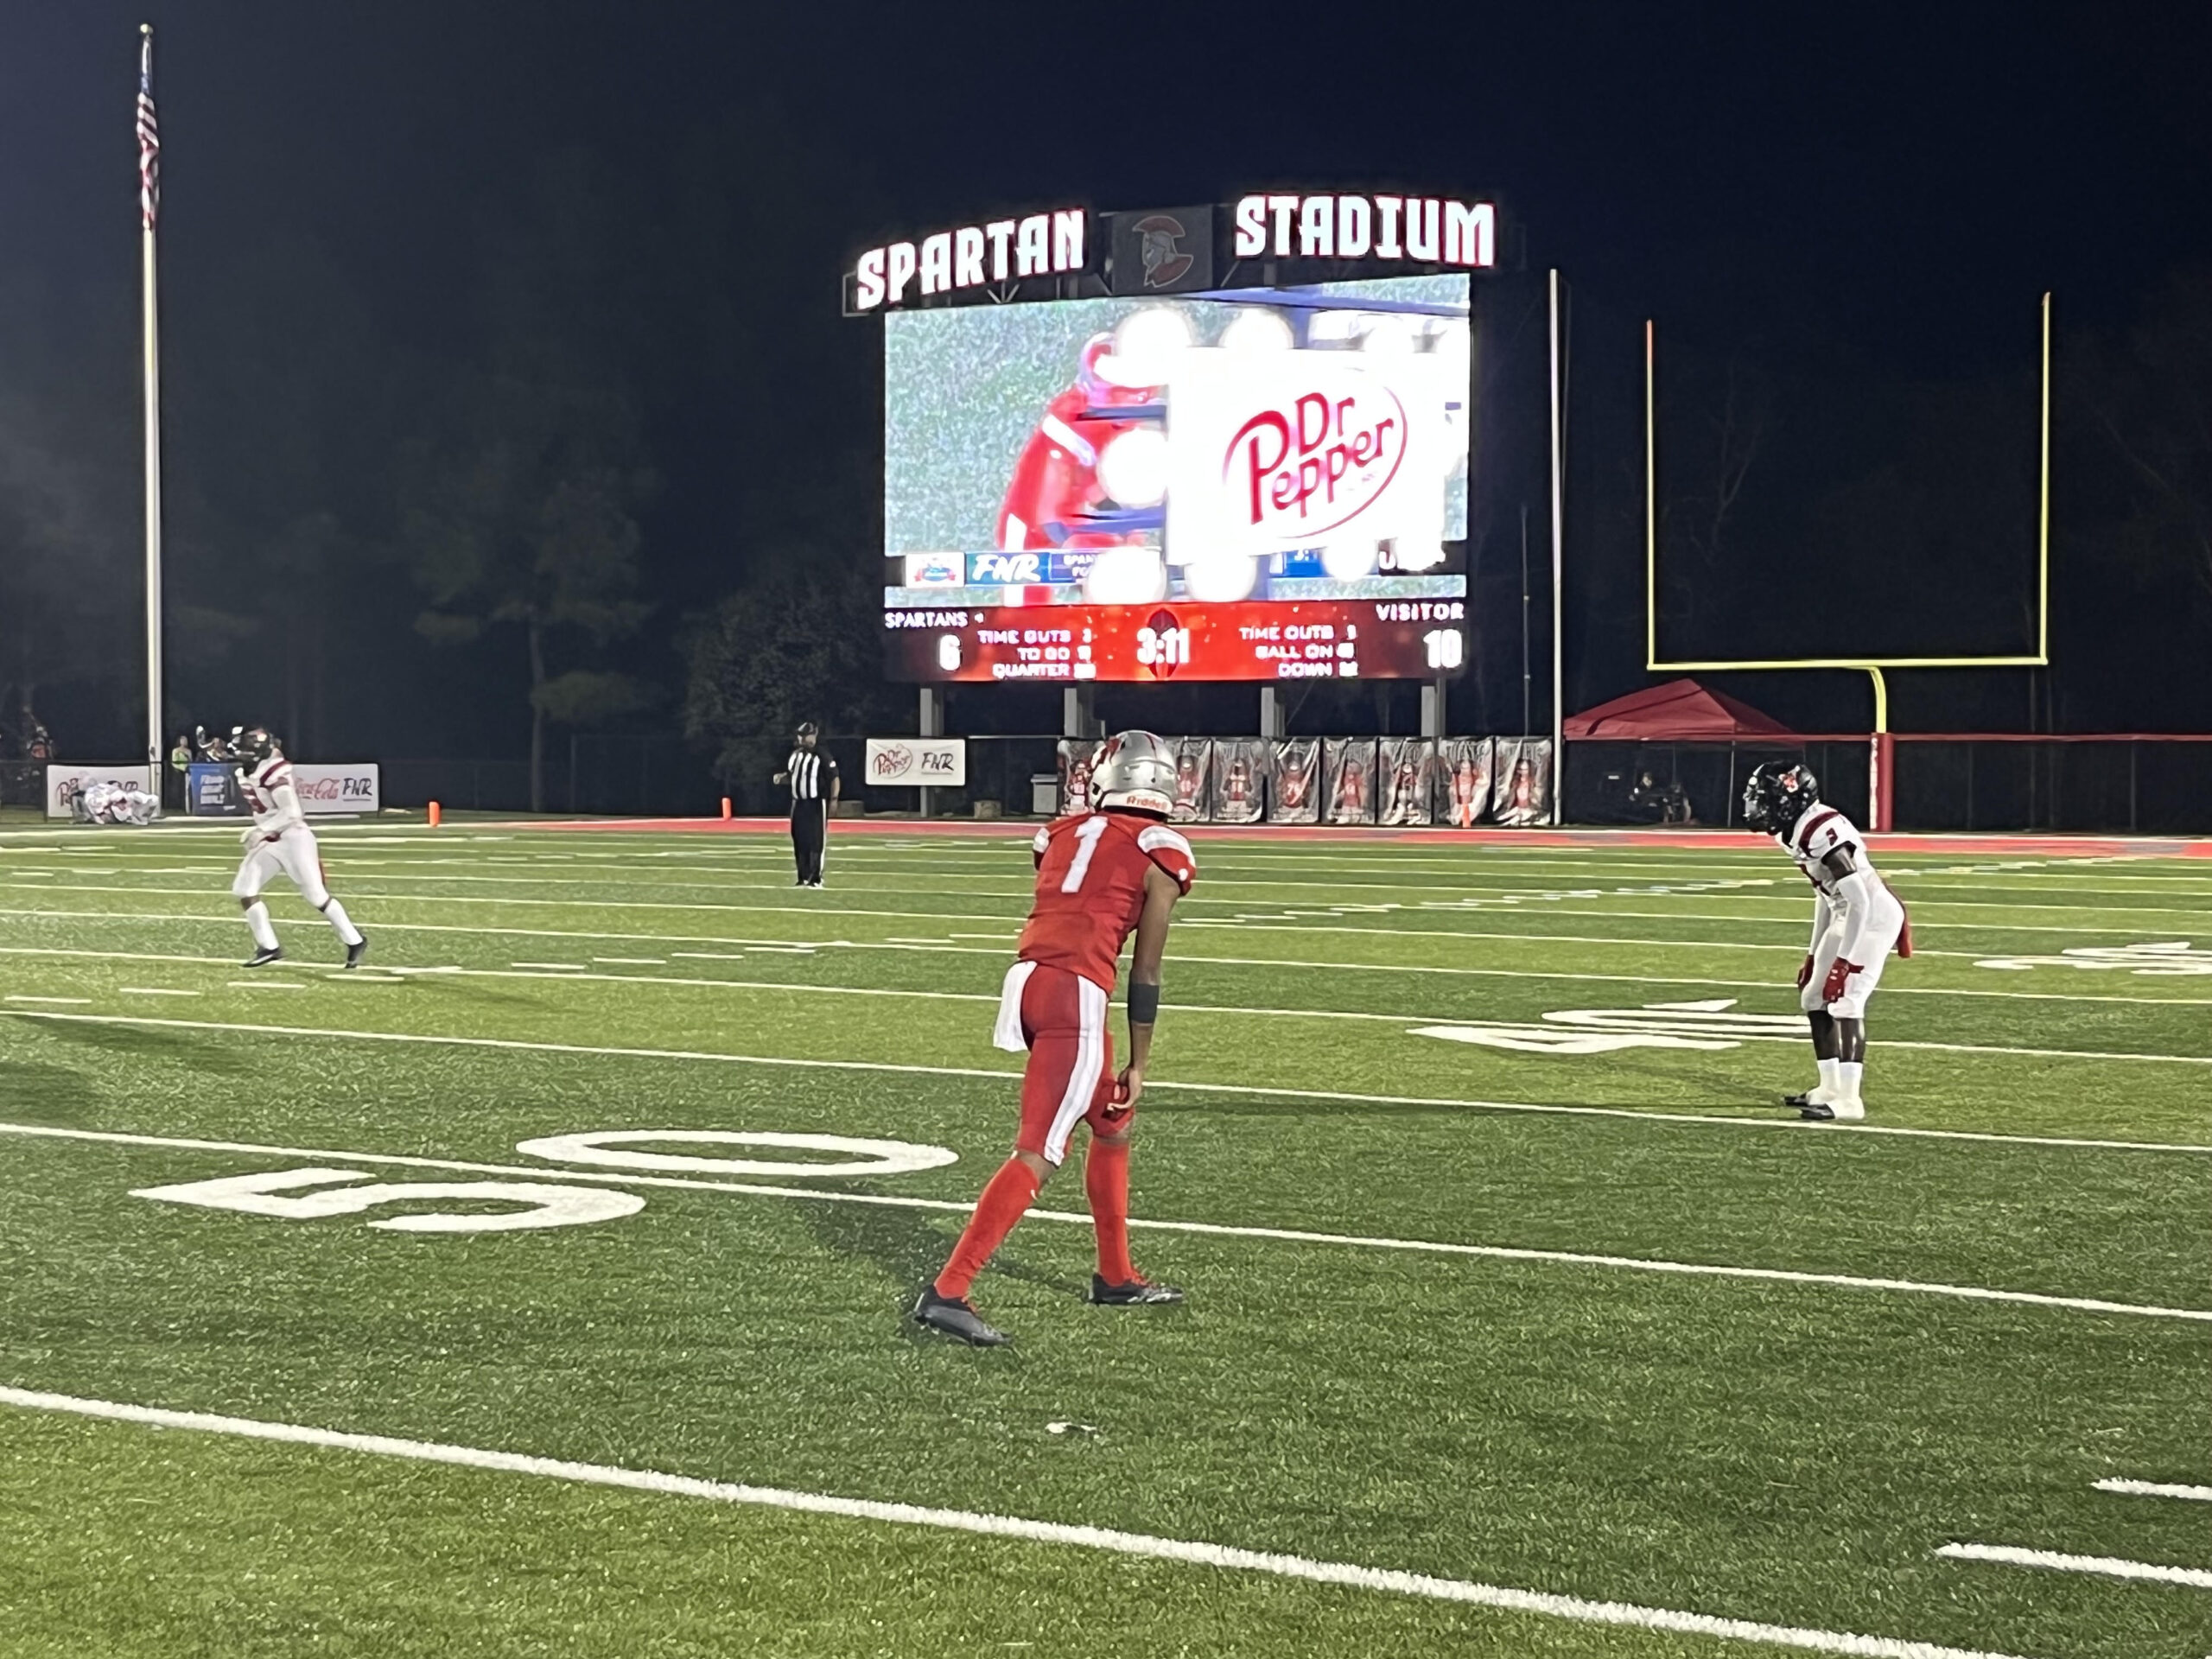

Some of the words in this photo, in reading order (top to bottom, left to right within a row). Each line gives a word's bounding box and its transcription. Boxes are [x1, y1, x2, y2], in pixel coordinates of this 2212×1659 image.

[857, 209, 1085, 310] SPARTAN
[1235, 194, 1495, 267] STADIUM
[1294, 391, 1356, 457] Dr
[1222, 410, 1395, 525] Pepper
[972, 554, 1041, 582] FNR
[885, 612, 969, 628] SPARTANS
[1376, 603, 1465, 620] VISITOR
[977, 630, 1020, 644] TIME
[1024, 630, 1071, 643] OUTS
[1239, 626, 1281, 640] TIME
[1284, 625, 1335, 639] OUTS
[939, 634, 962, 671] 6
[1017, 647, 1040, 661] TO
[1136, 627, 1190, 664] 3:11
[1255, 645, 1301, 659] BALL
[1305, 644, 1333, 659] ON
[1423, 629, 1462, 669] 10
[993, 664, 1070, 678] QUARTER
[1279, 662, 1332, 677] DOWN
[921, 752, 955, 772] FNR
[1061, 816, 1109, 893] 1
